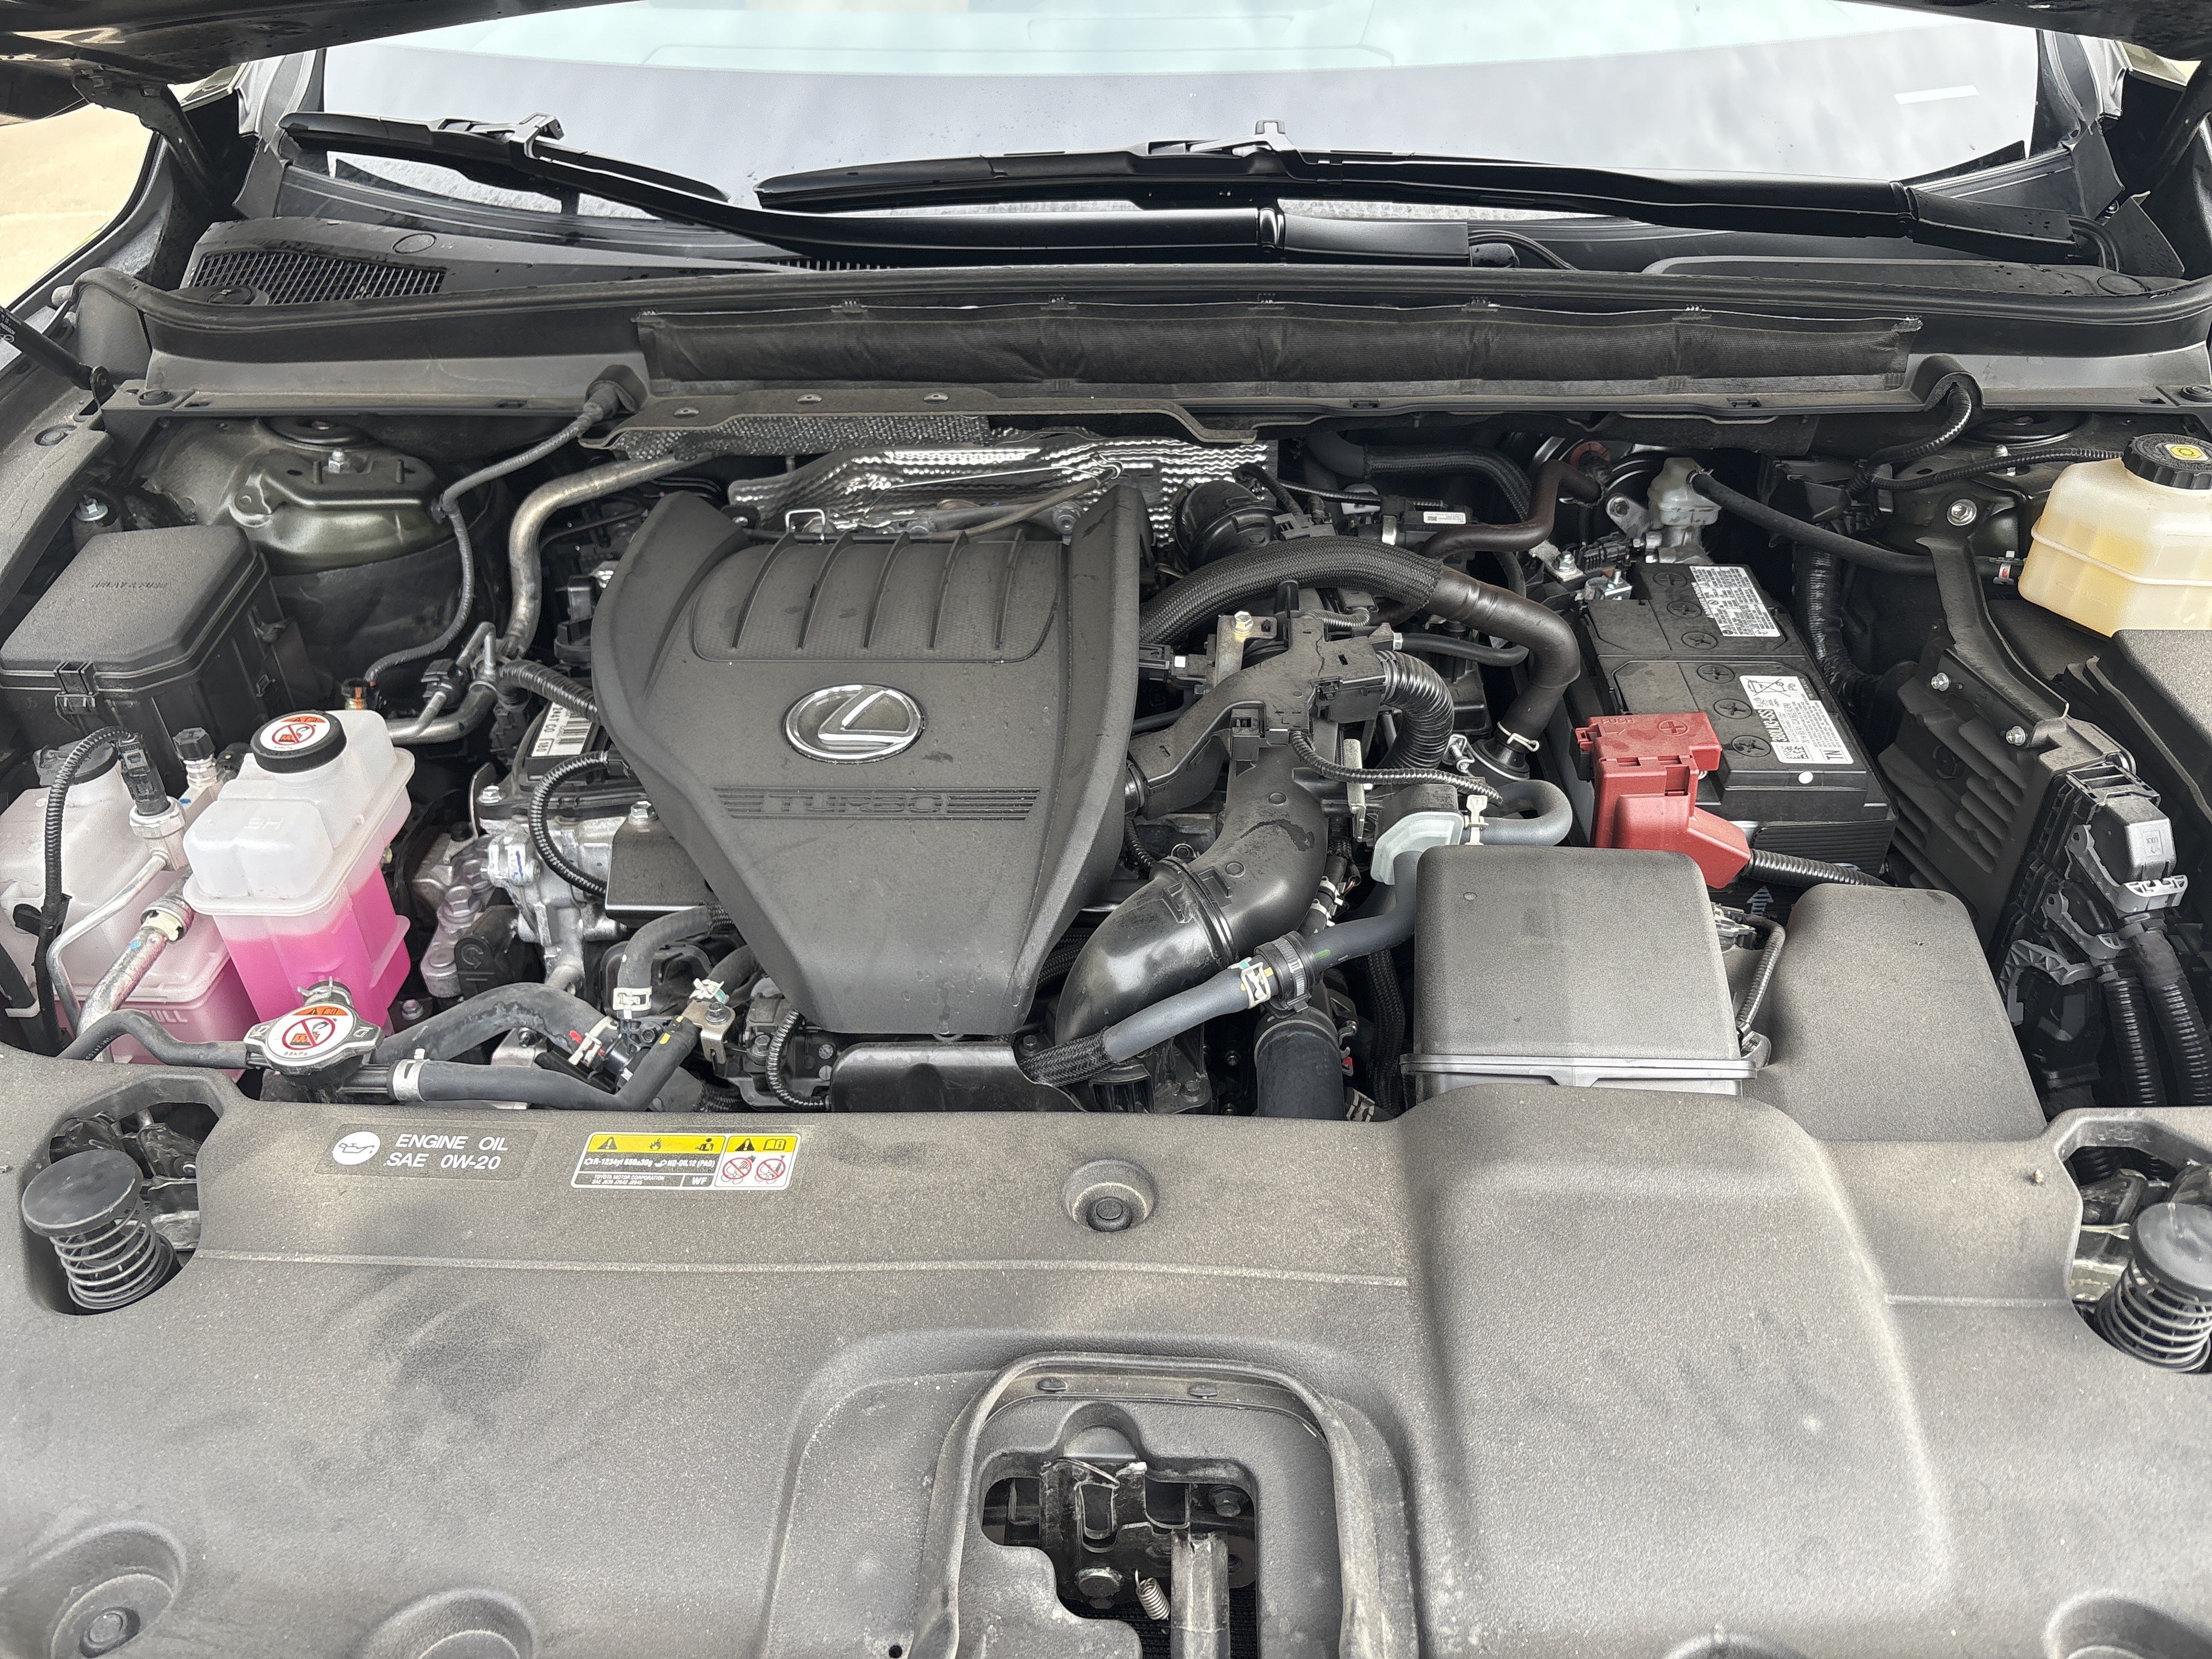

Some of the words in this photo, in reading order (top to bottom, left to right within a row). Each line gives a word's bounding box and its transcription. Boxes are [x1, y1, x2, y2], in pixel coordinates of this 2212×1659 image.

[1788, 683, 1798, 691] Pb
[1822, 750, 1844, 760] TN
[769, 794, 942, 812] TURBO
[146, 1009, 188, 1023] ULL
[396, 1133, 469, 1149] ENGINE
[478, 1136, 509, 1151] OIL
[386, 1152, 429, 1167] SAE
[441, 1154, 501, 1170] 0W-20
[692, 1176, 708, 1185] WF
